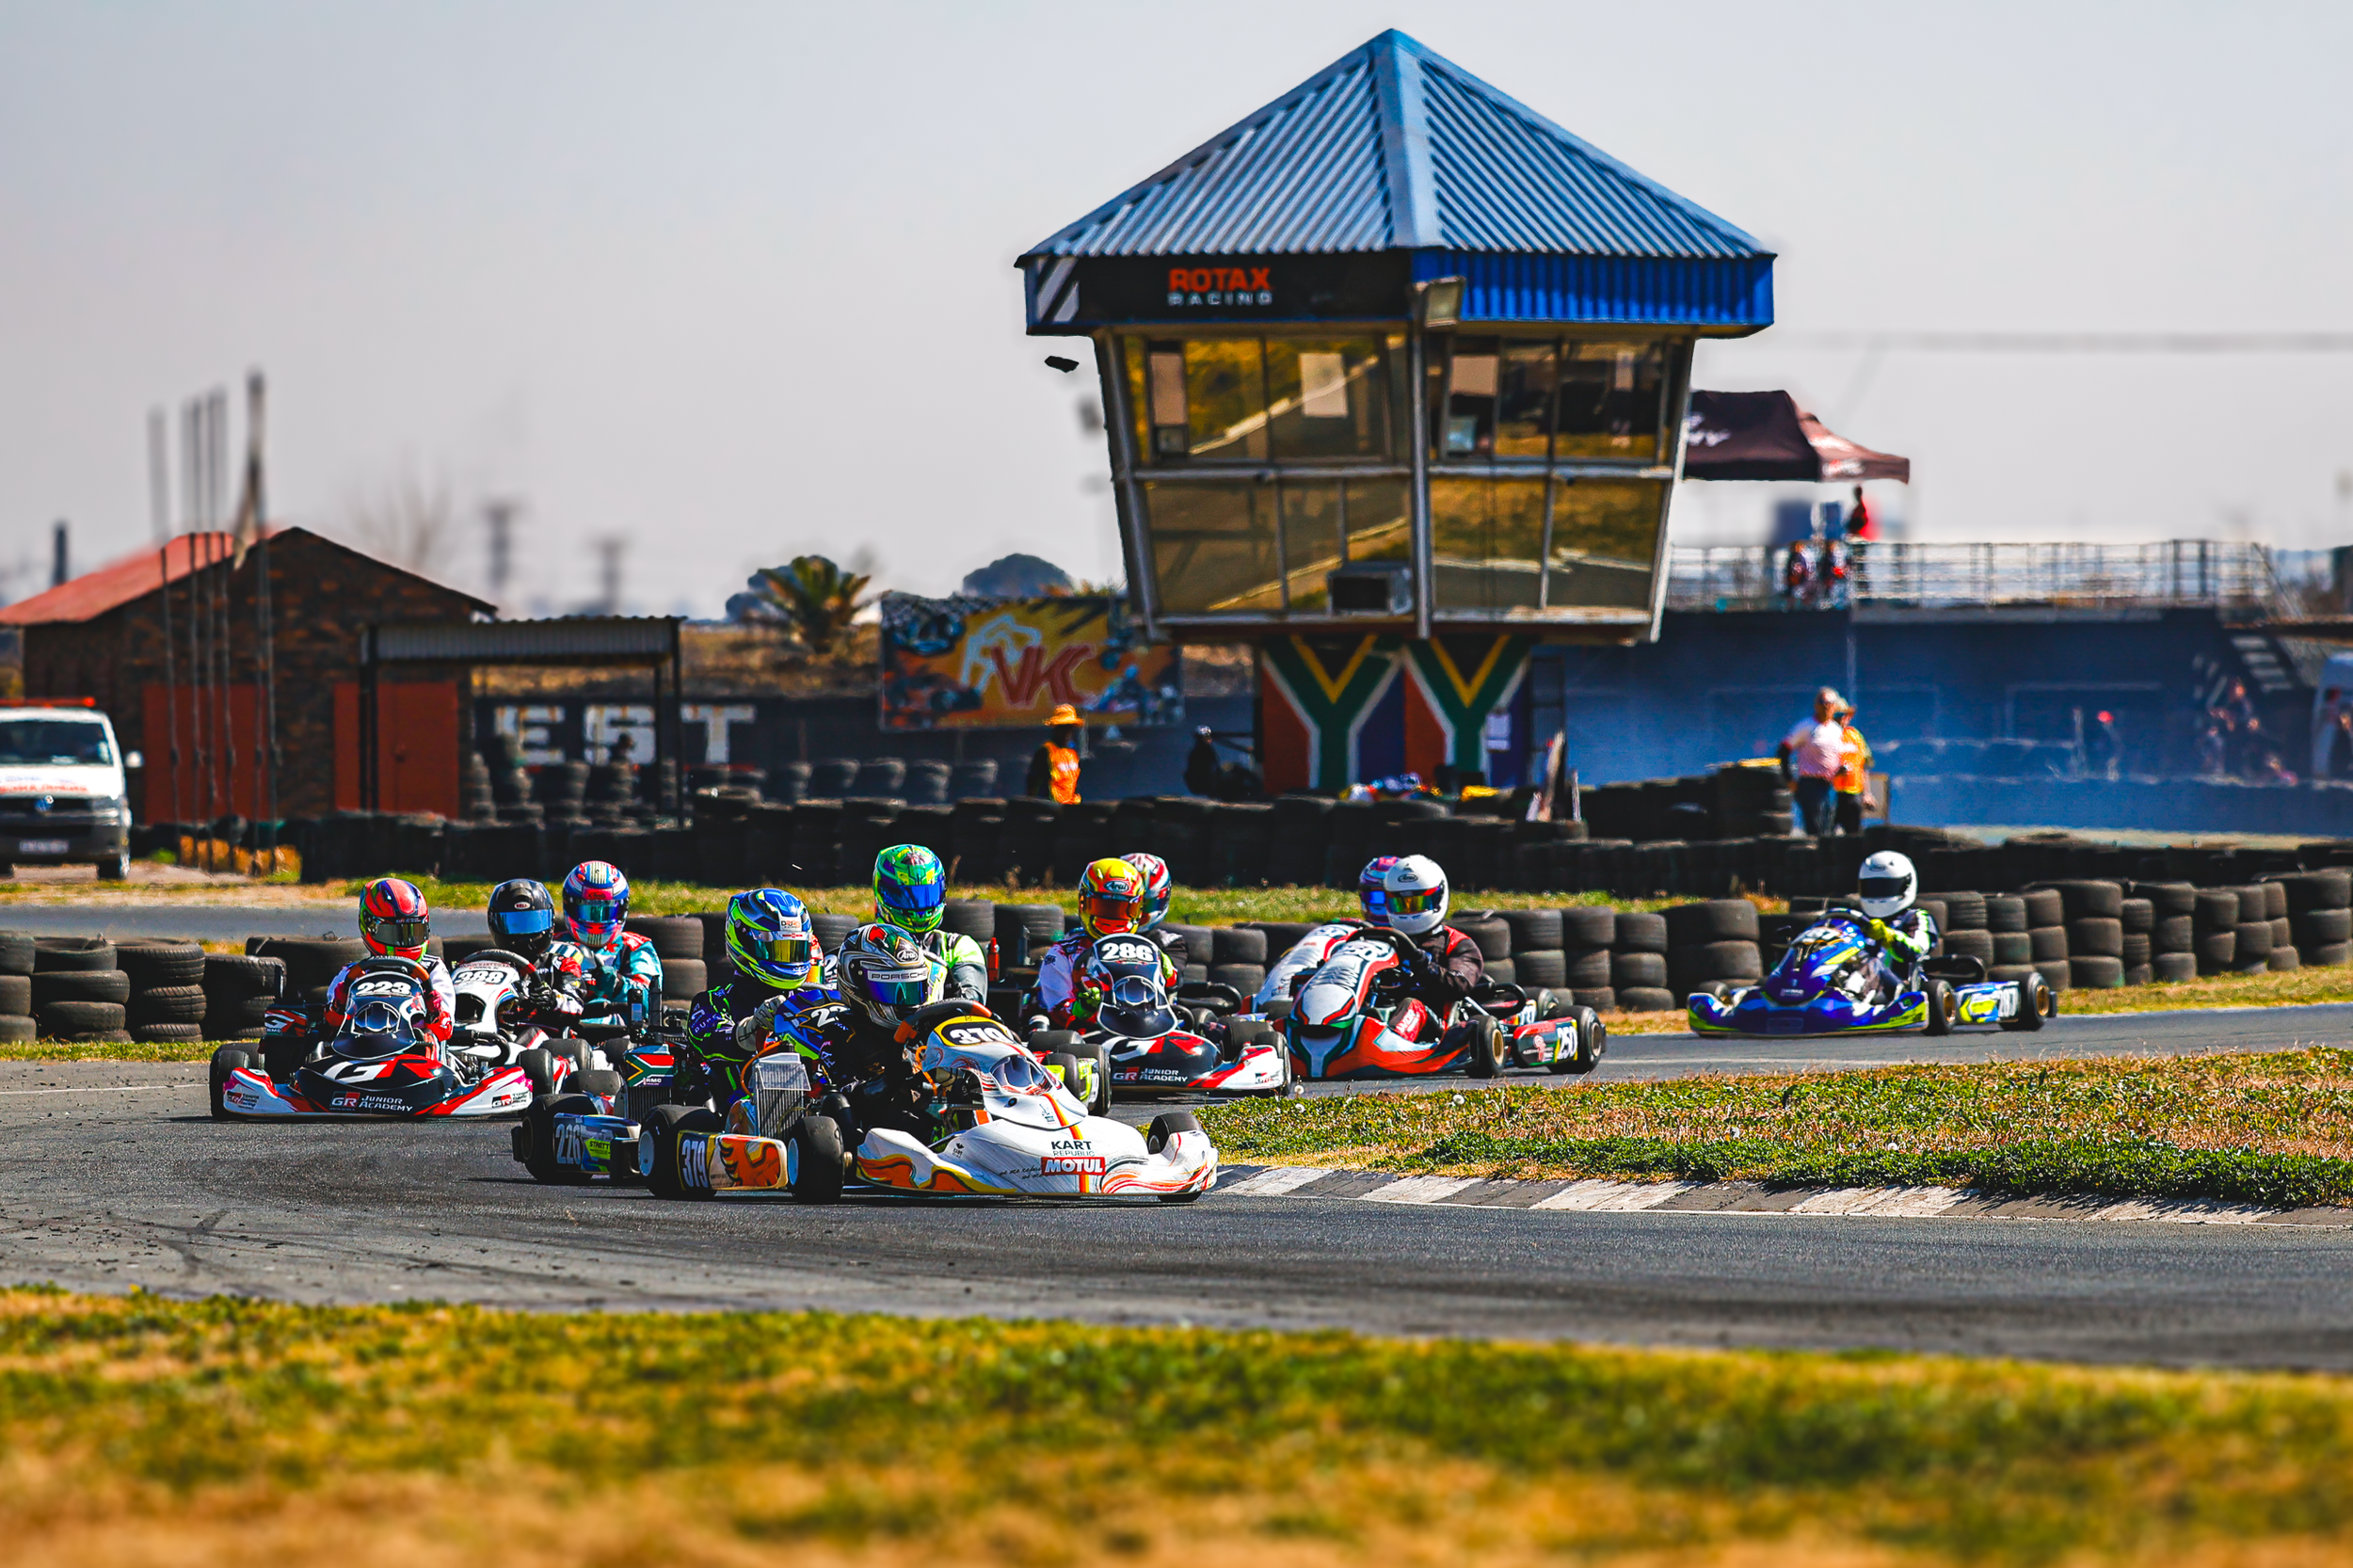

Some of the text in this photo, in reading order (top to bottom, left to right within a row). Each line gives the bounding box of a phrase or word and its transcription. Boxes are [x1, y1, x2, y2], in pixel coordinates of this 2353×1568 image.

[1169, 268, 1270, 292] ROTAX
[1167, 291, 1273, 306] RACING
[472, 704, 758, 764] EST
[1107, 881, 1128, 892] Arai
[1101, 943, 1154, 962] 286
[455, 970, 504, 984] 388
[872, 972, 927, 981] PORSCHE
[357, 981, 412, 996] 223
[1556, 1026, 1578, 1060] 250
[1112, 1071, 1138, 1081] GR
[1140, 1073, 1188, 1082] ACADEMY
[1141, 1067, 1179, 1076] JUNIOR
[331, 1096, 358, 1107] GR
[359, 1100, 413, 1112] ACADEMY
[361, 1095, 404, 1105] JUNIOR
[493, 1098, 512, 1108] GR
[555, 1124, 582, 1164] 226
[1051, 1141, 1092, 1150] KART
[681, 1139, 709, 1188] 379
[1045, 1158, 1103, 1174] MOTUL
